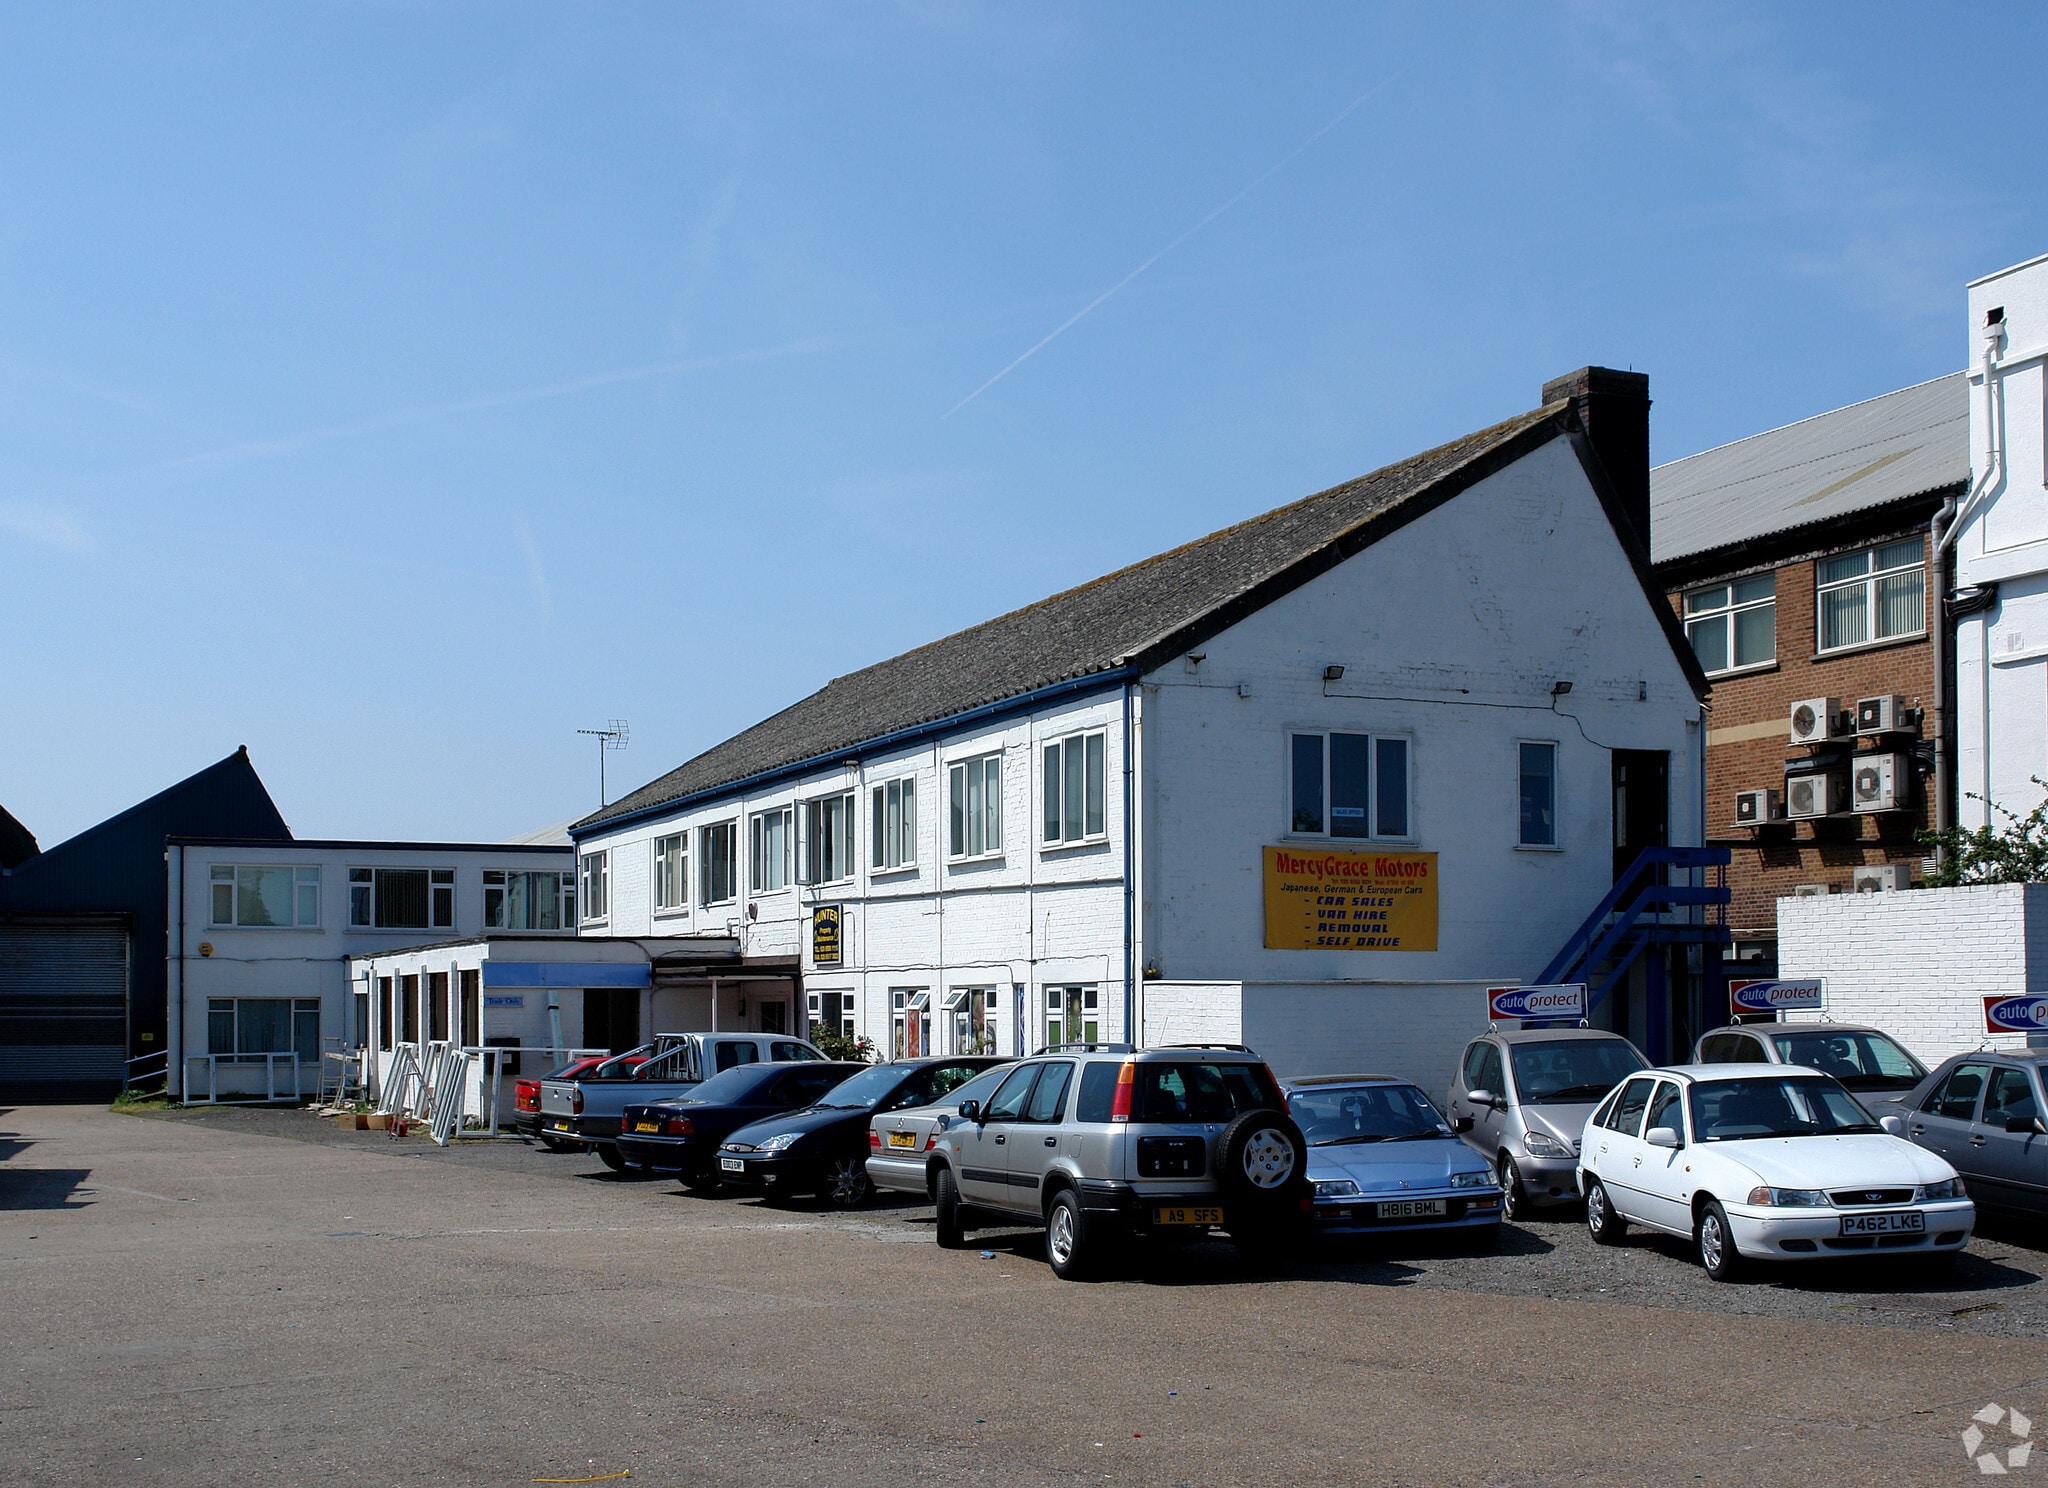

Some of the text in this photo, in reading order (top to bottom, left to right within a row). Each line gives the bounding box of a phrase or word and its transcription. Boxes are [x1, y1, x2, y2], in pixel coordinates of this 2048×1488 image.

[1277, 854, 1428, 881] MercyGrace Motors
[1281, 884, 1423, 895] Japanese, German & European Cars
[1317, 897, 1394, 907] CAR SALES
[1318, 910, 1387, 920] VAN HIRE
[1318, 923, 1388, 933] REMOVAL
[1317, 937, 1400, 946] SELF DRIVE
[1742, 987, 1818, 1003] auto protect
[1501, 996, 1524, 1009] auto
[1530, 994, 1578, 1010] protect
[2000, 1005, 2048, 1022] auto p
[1168, 1210, 1219, 1222] A9 SFS
[1382, 1203, 1441, 1217] H816 BML
[1845, 1215, 1922, 1232] P462 LKE
